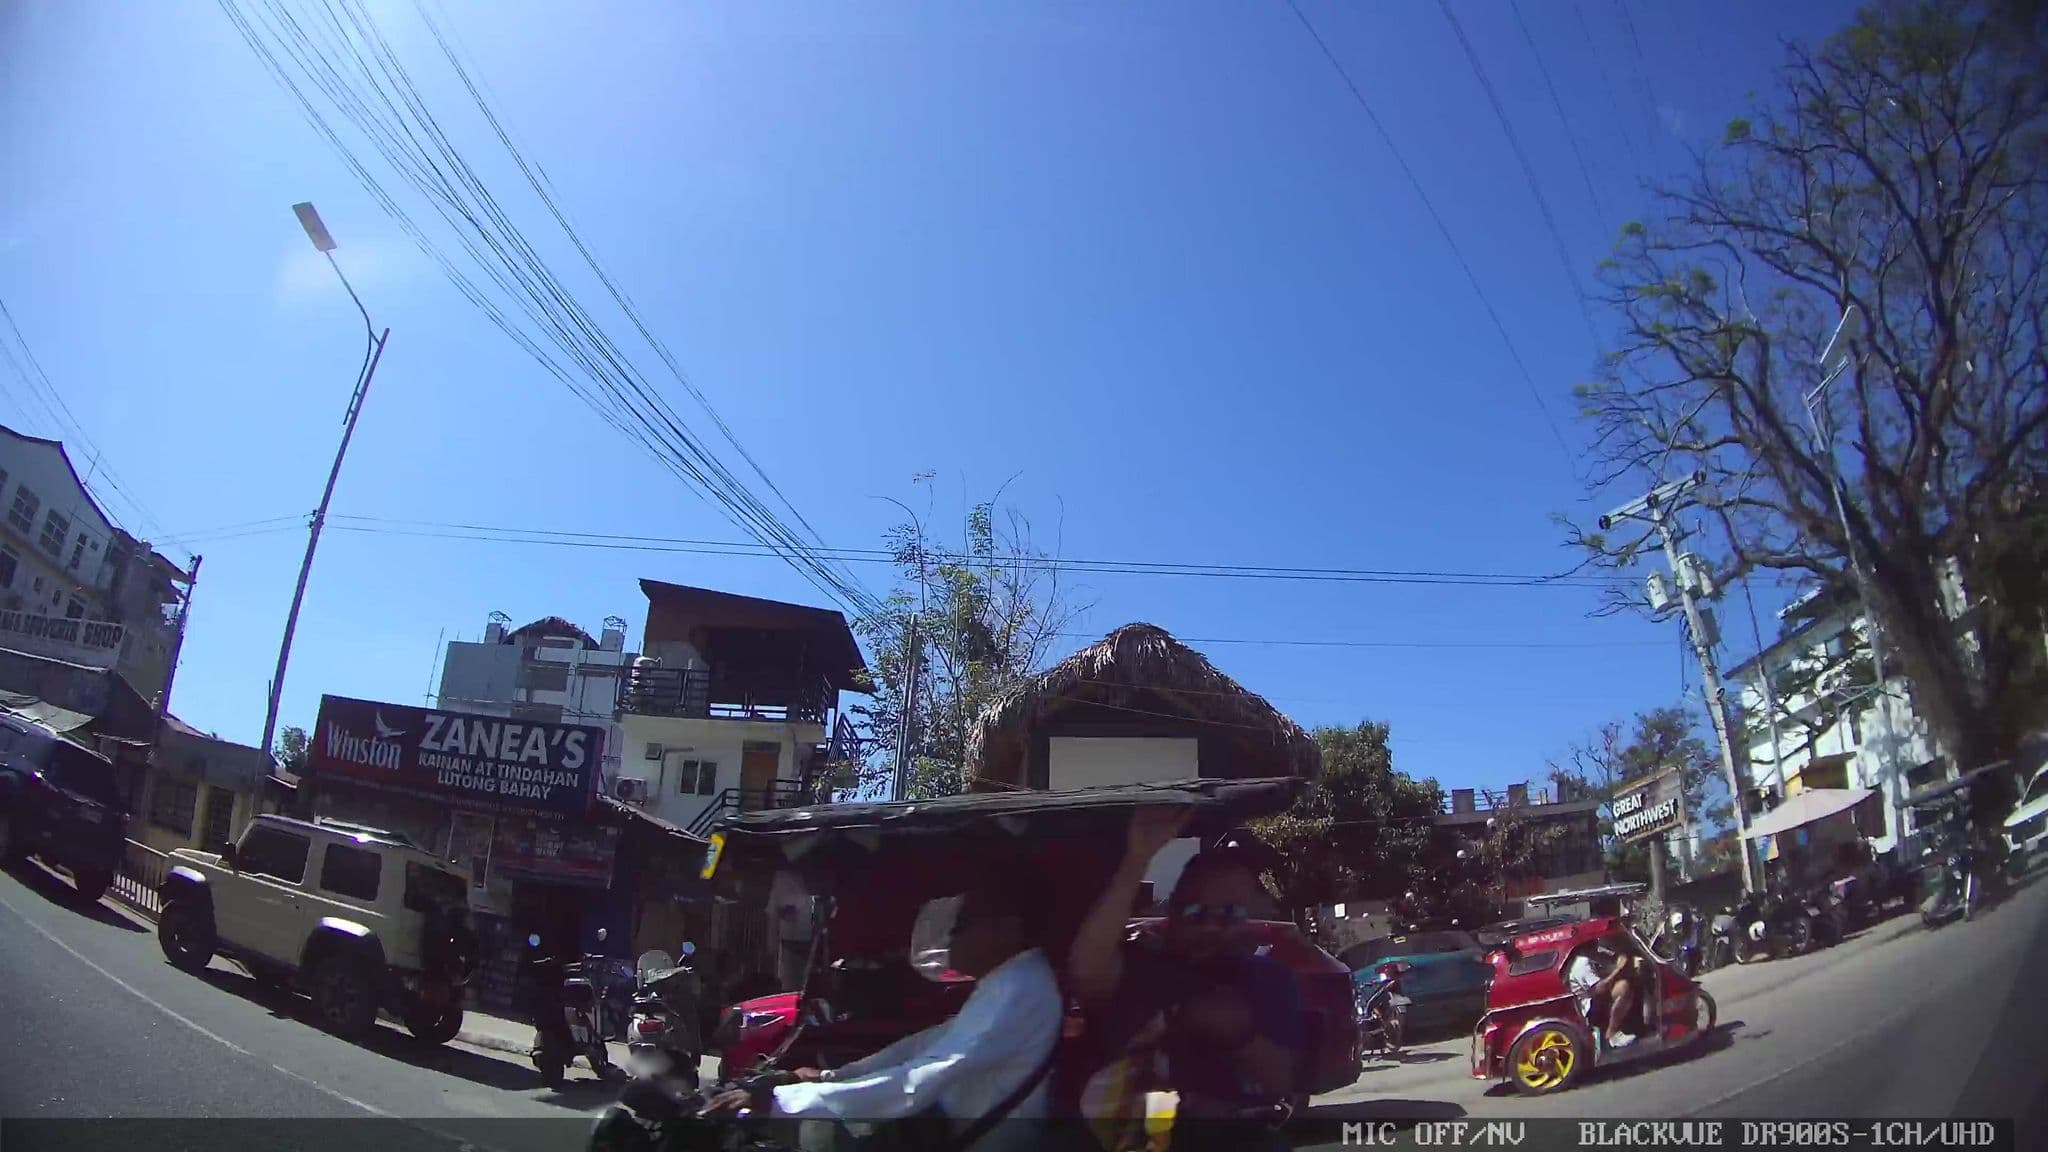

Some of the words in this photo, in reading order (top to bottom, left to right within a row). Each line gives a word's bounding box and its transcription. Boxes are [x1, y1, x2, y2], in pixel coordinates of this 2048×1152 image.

[326, 720, 402, 770] Winston
[418, 713, 588, 769] ZANEA'S
[418, 752, 472, 774] KAINAN
[474, 760, 492, 777] AT
[496, 764, 580, 788] TINDAHAN
[438, 771, 496, 792] LUTONG
[499, 780, 552, 800] BAHAY
[1612, 793, 1642, 818] GREAT
[1613, 799, 1675, 837] NORTHWEST
